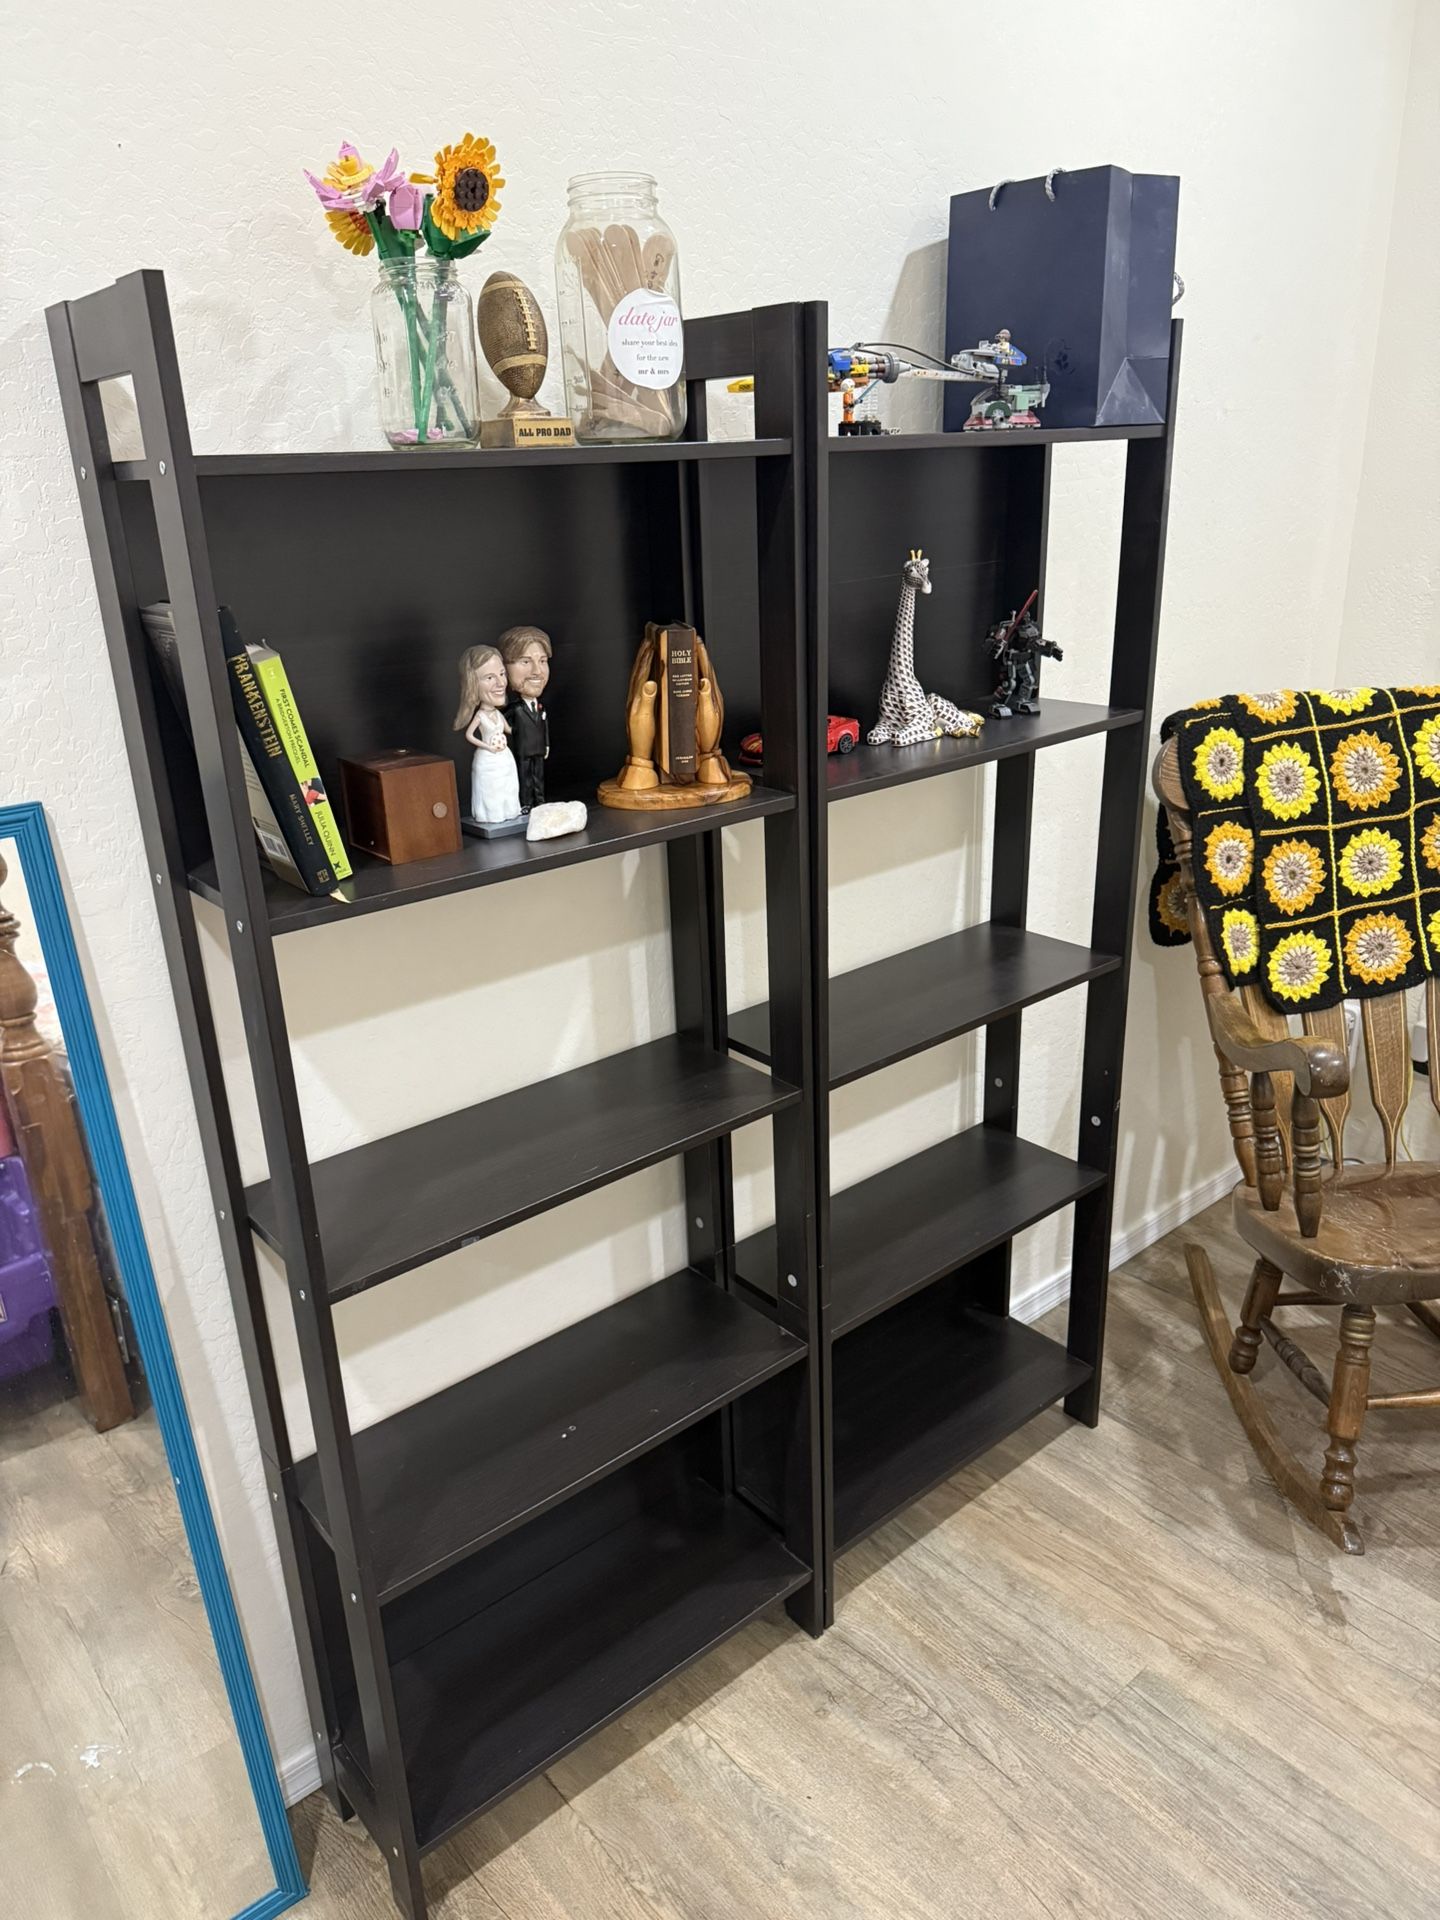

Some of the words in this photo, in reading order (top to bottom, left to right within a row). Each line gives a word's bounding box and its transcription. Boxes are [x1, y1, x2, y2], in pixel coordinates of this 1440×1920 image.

[618, 307, 655, 327] date
[649, 311, 678, 333] jar
[621, 338, 640, 346] share
[640, 340, 655, 349] your
[656, 339, 668, 347] best
[636, 353, 646, 361] for
[646, 353, 657, 361] the
[650, 367, 656, 375] &
[519, 428, 534, 437] ALL
[536, 428, 552, 436] PRO
[554, 427, 571, 436] DAD
[671, 649, 692, 657] HOLY
[231, 652, 283, 758] FRANKENSTEIN
[277, 703, 293, 740] BRIDGERTON
[289, 739, 302, 764] PREQUEL
[279, 688, 290, 707] FIRST
[286, 708, 299, 735] COMES
[294, 734, 310, 768] SCANDAL
[289, 793, 301, 814] MARY
[297, 814, 315, 846] SHELLEY
[315, 810, 328, 830] JULIA
[323, 829, 337, 857] QUINN
